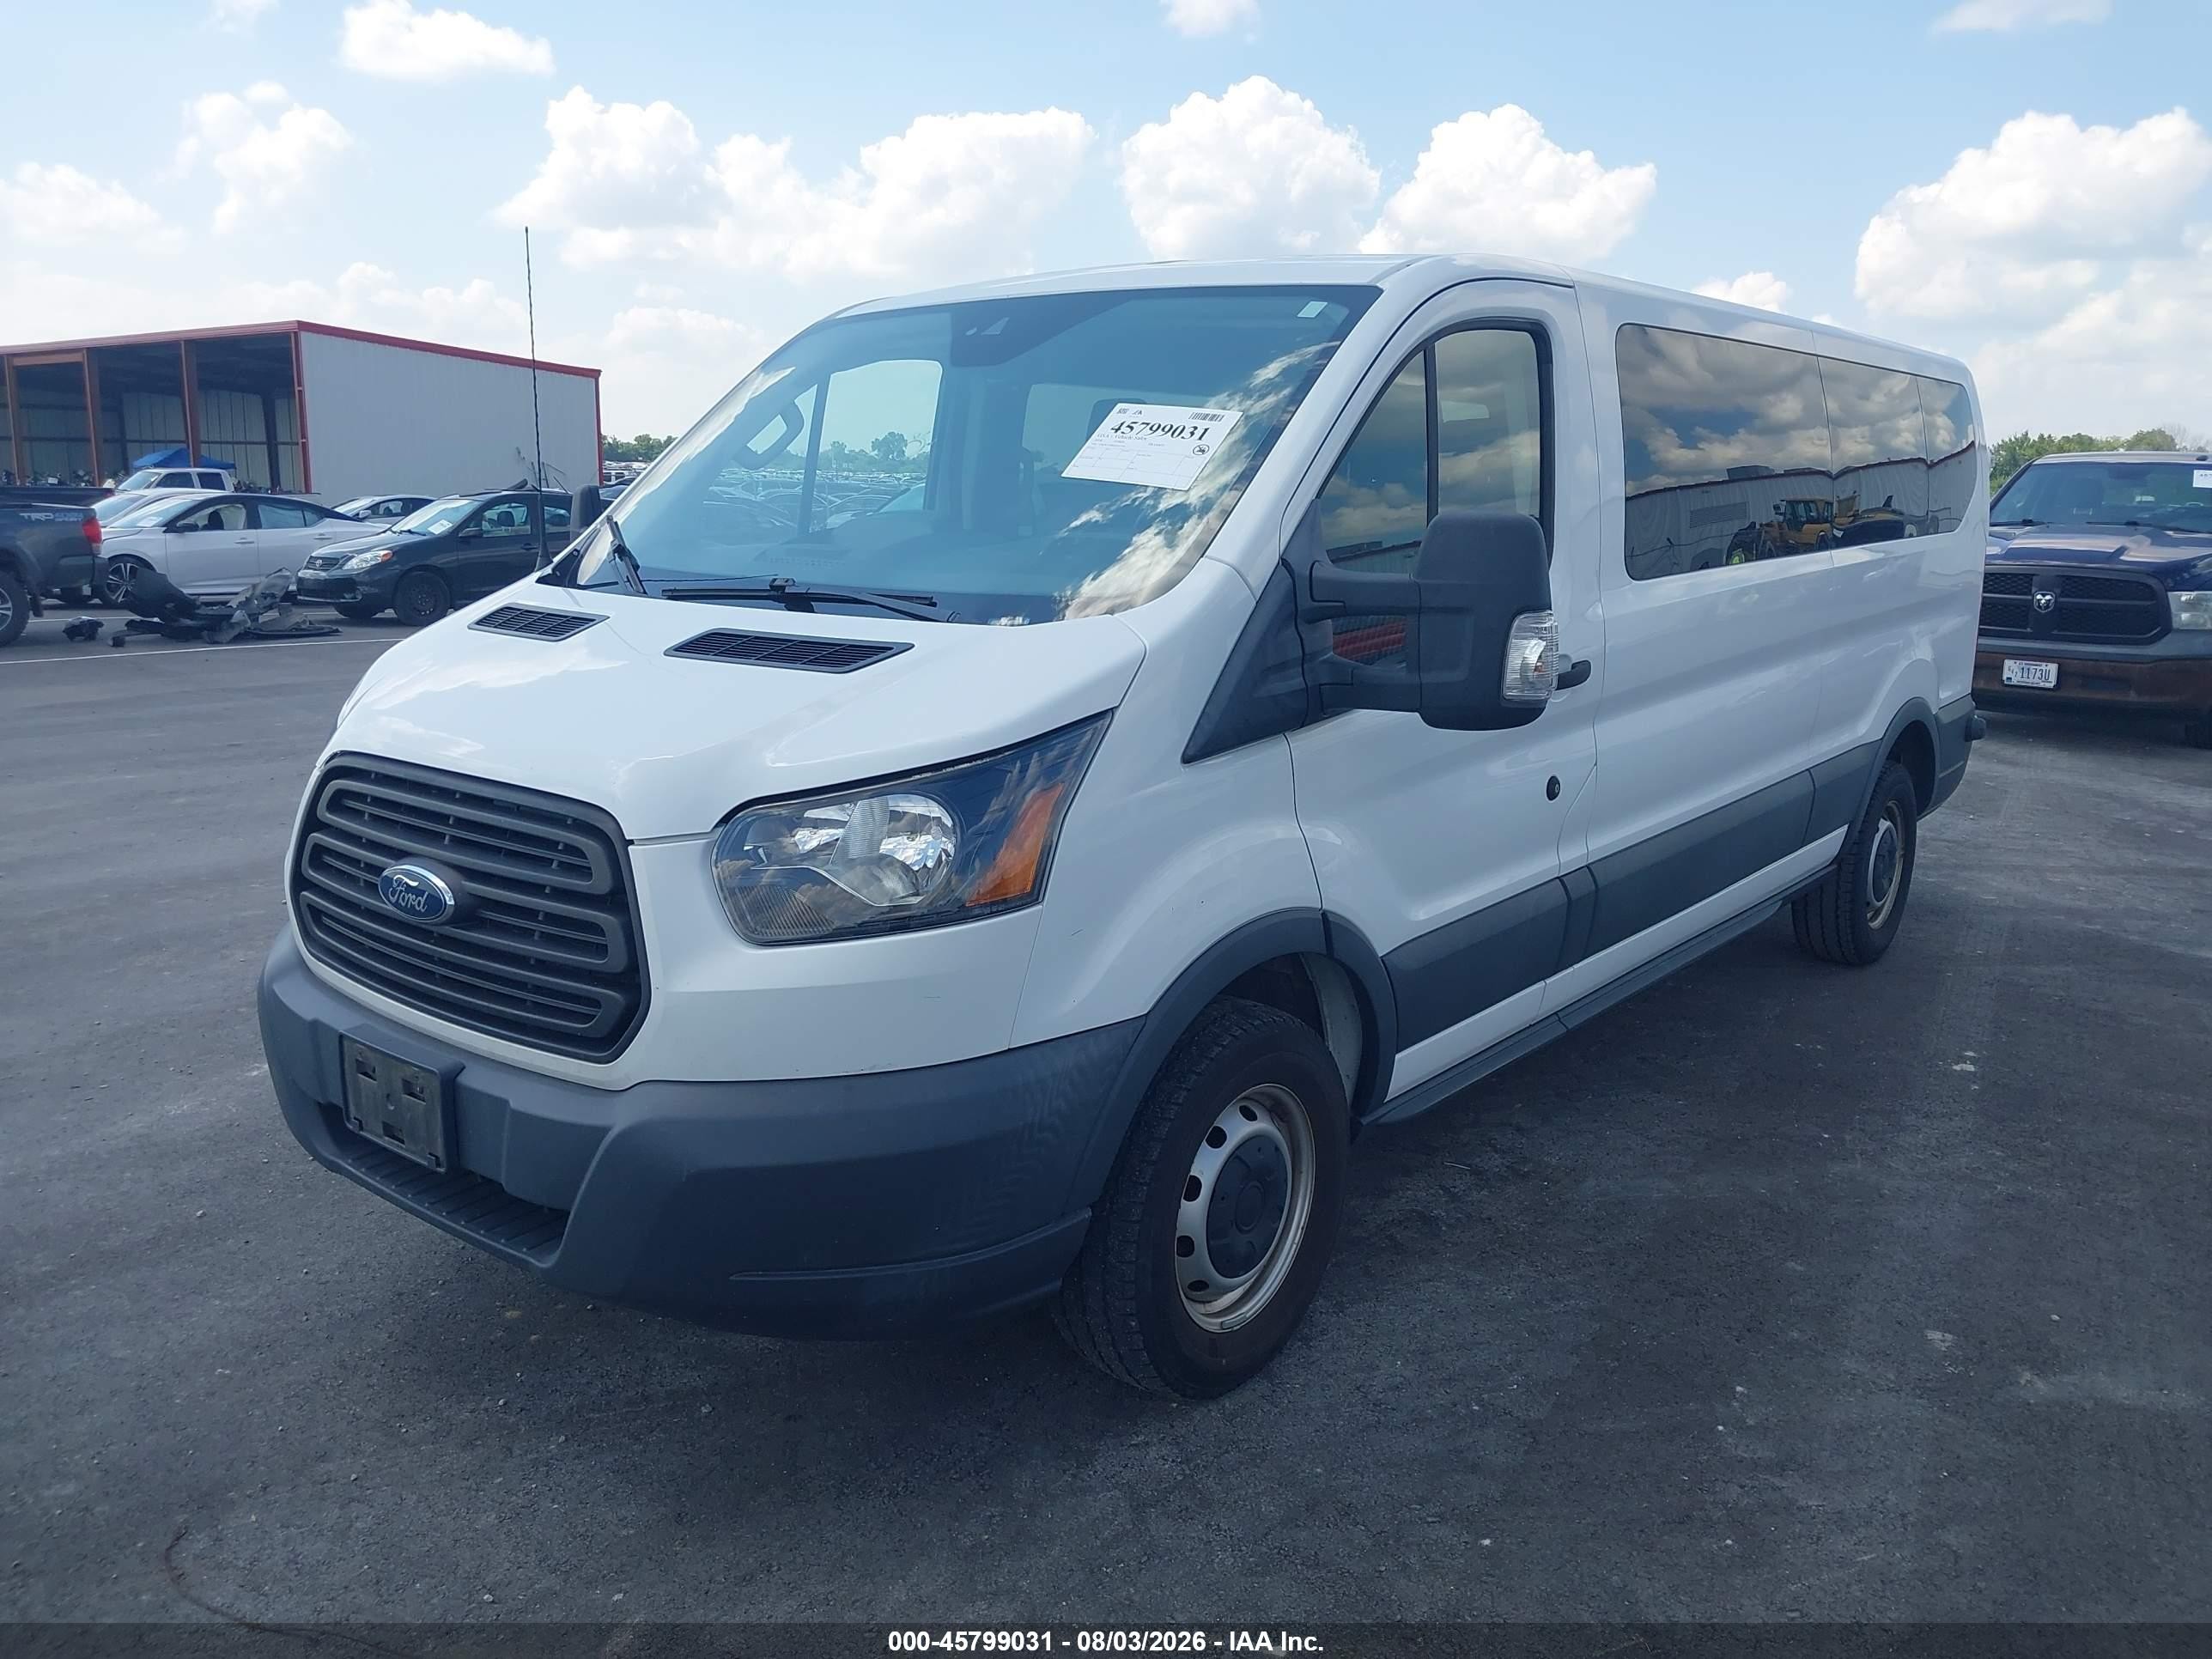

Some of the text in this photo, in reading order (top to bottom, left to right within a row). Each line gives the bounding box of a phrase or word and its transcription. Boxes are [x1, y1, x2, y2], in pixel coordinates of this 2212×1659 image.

[1110, 420, 1210, 441] 45799031
[19, 513, 54, 521] TRD
[2021, 666, 2051, 680] 1173U
[388, 874, 428, 913] Ford
